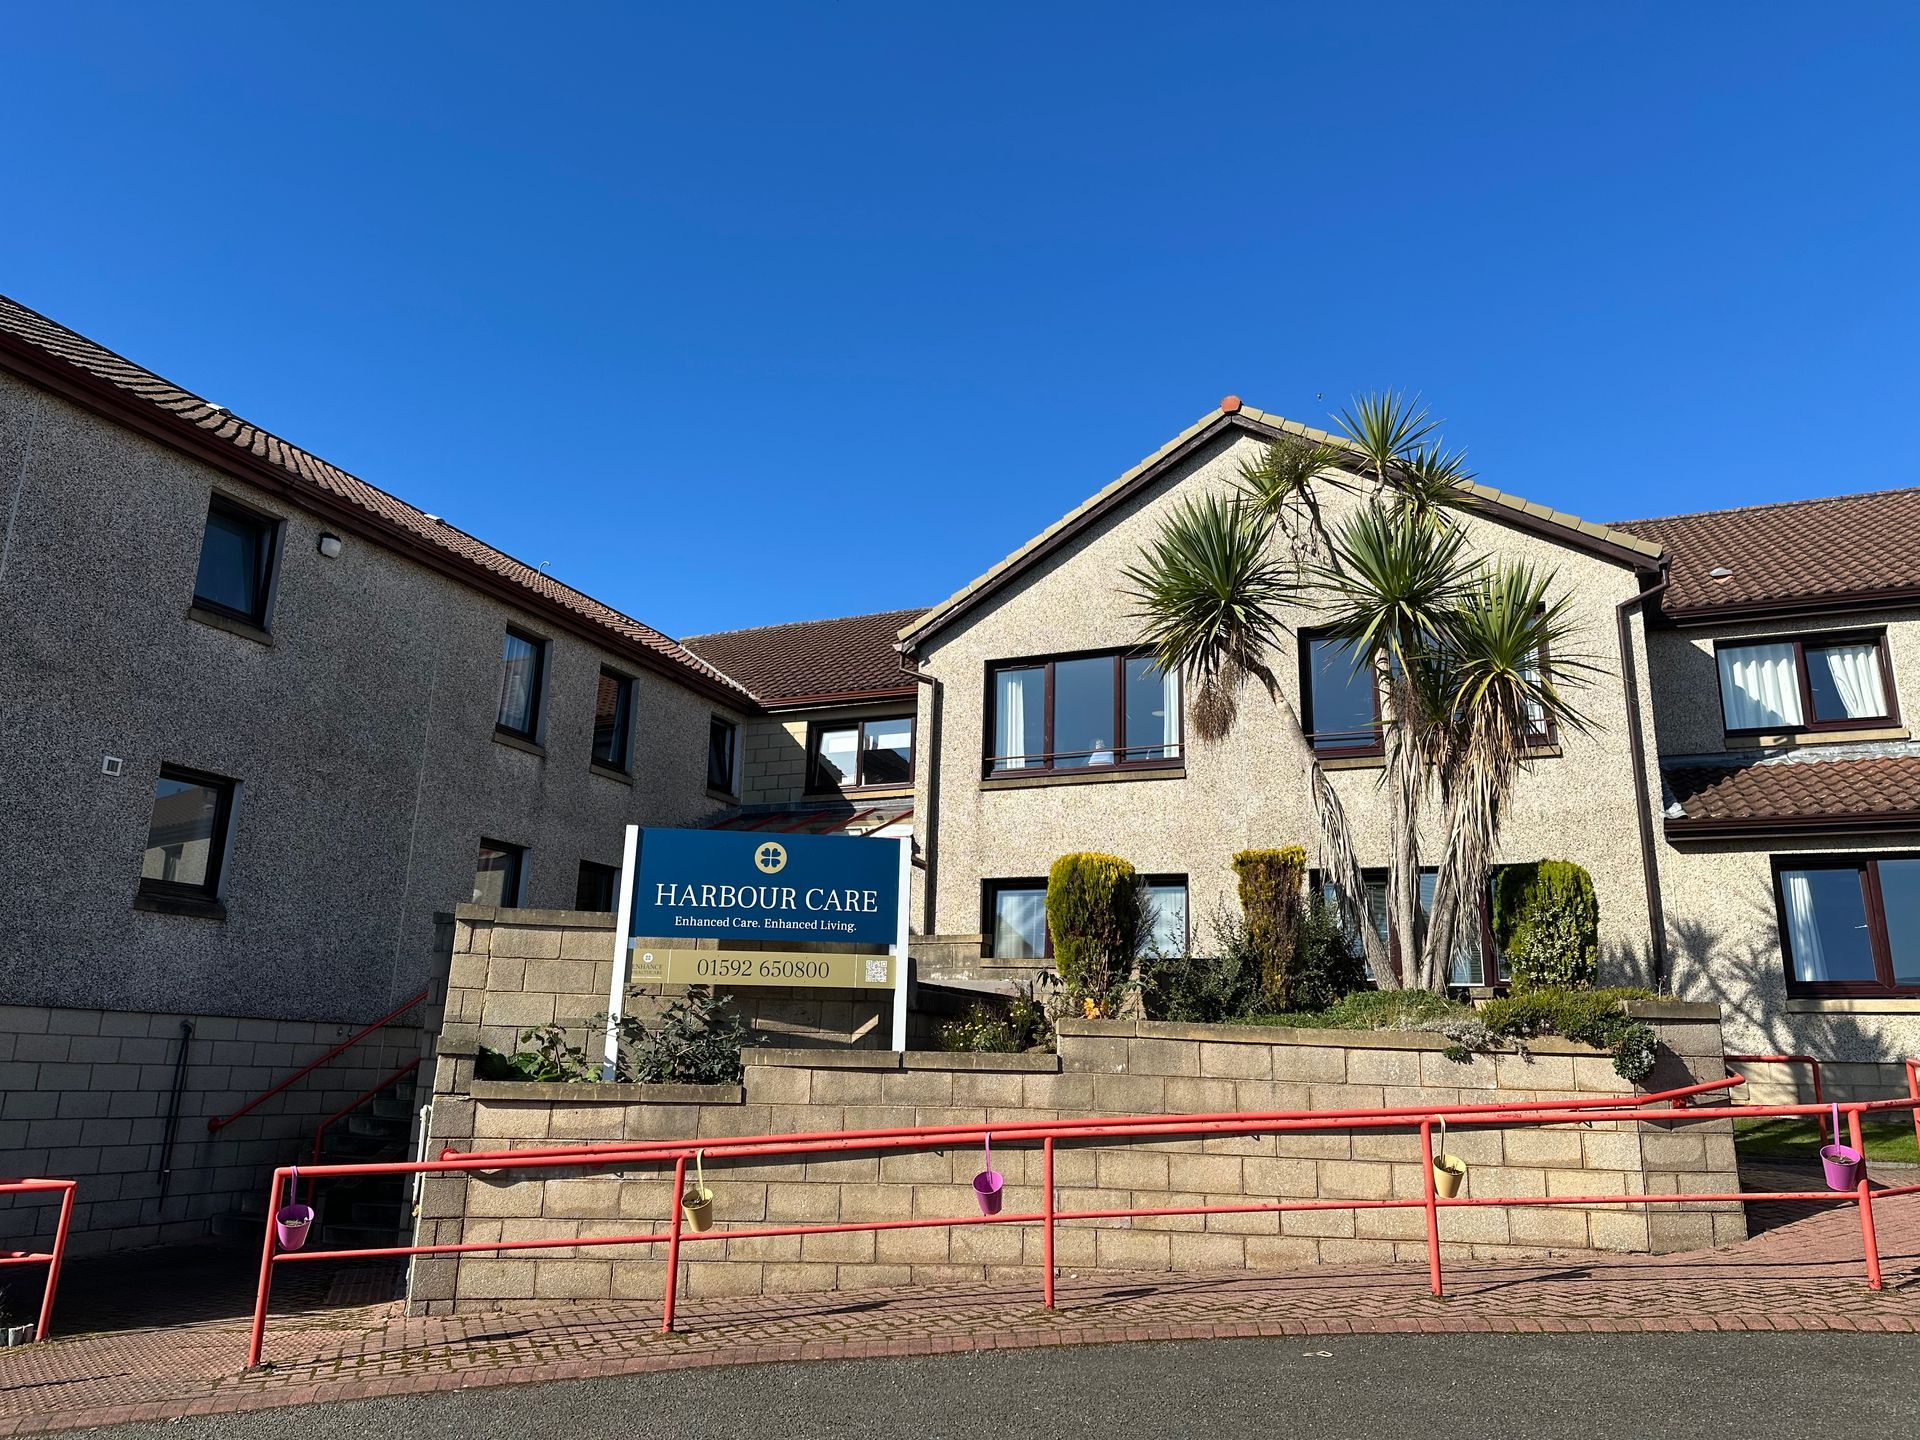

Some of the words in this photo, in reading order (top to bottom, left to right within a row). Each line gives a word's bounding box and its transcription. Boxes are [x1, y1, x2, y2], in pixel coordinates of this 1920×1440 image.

[655, 883, 797, 909] HARBOUR
[806, 888, 878, 912] CARE
[675, 916, 730, 927] Enhanced
[732, 918, 761, 928] Care.
[764, 919, 818, 930] Enhanced
[820, 921, 857, 932] Living.
[697, 958, 752, 977] 01592
[759, 959, 830, 979] 650800
